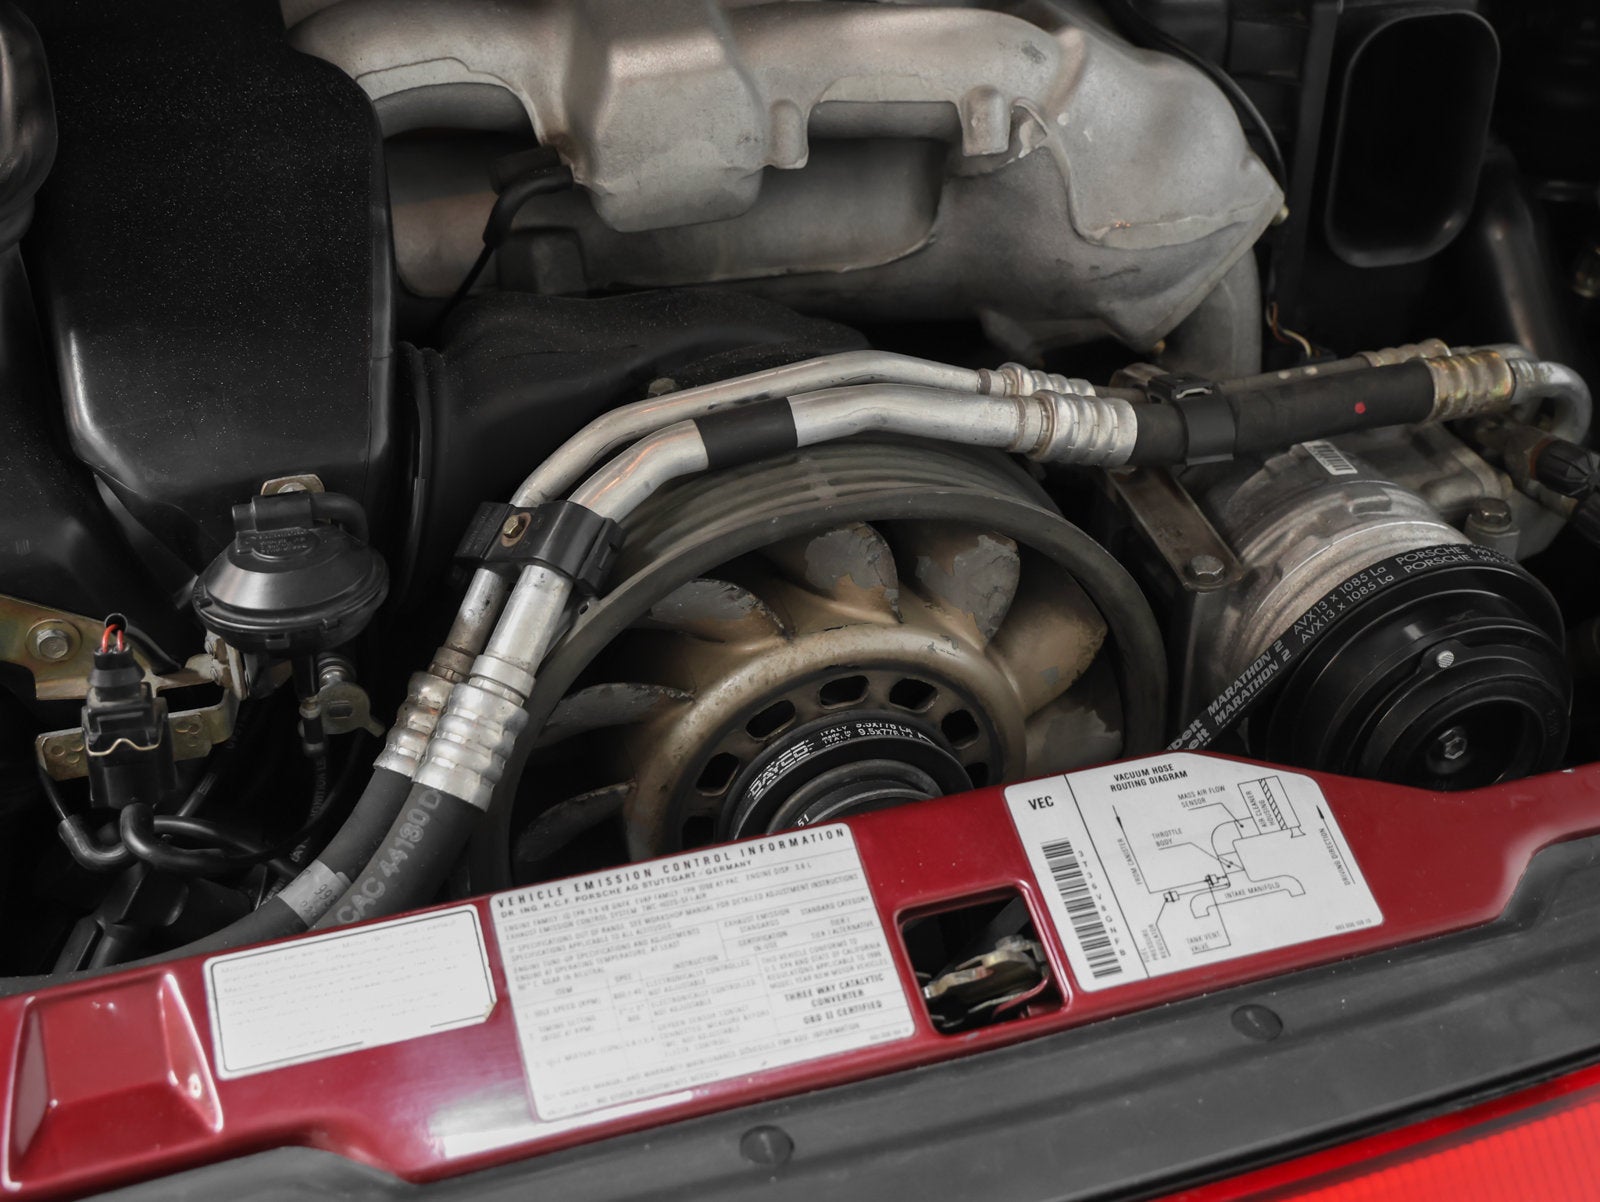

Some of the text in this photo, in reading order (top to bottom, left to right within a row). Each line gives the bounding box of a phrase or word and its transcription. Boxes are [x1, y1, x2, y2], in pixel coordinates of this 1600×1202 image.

[1207, 651, 1272, 716] MARATHON
[1273, 640, 1284, 653] 2
[1293, 600, 1329, 635] AVX13
[1339, 574, 1368, 594] 1085
[1370, 566, 1387, 577] La
[1395, 546, 1464, 565] PORSCHE
[1214, 660, 1279, 725] MARATHON
[1281, 648, 1292, 662] 2
[1301, 609, 1336, 644] AVX13
[1347, 583, 1377, 603] 1085
[1378, 574, 1395, 586] La
[1403, 554, 1472, 573] PORSCHE
[820, 725, 847, 736] ITALY
[748, 739, 814, 801] DAYCO
[1113, 763, 1174, 782] VACUUM HOSE
[1110, 770, 1188, 792] ROUTING DIAGRAM
[1028, 795, 1054, 811] VEC
[1177, 785, 1226, 801] MASS AIR FLOW
[1181, 797, 1207, 808] SENSOR
[1245, 791, 1262, 815] CLEANER
[1258, 799, 1276, 827] HOUSING
[1151, 827, 1183, 840] THROTTLE
[1156, 838, 1173, 848] BODY
[336, 877, 386, 924] CAC
[418, 789, 443, 810] D
[1319, 828, 1351, 886] DRIVING DIRECTION
[497, 886, 563, 908] VEHICLE
[573, 868, 651, 892] EMISSION
[661, 851, 730, 873] CONTROL
[740, 828, 844, 857] INFORMATION
[574, 887, 621, 902] PORSCHE
[625, 883, 638, 891] AG
[642, 871, 696, 888] STUTTGART
[704, 860, 751, 875] GERMANY
[1224, 881, 1281, 899] INTAKE MANIFOLD
[1186, 934, 1203, 945] TANK
[783, 972, 884, 1002] THREE WAY CATALYTIC
[810, 988, 864, 1007] CONVERTER
[835, 999, 882, 1017] CERTIFIED
